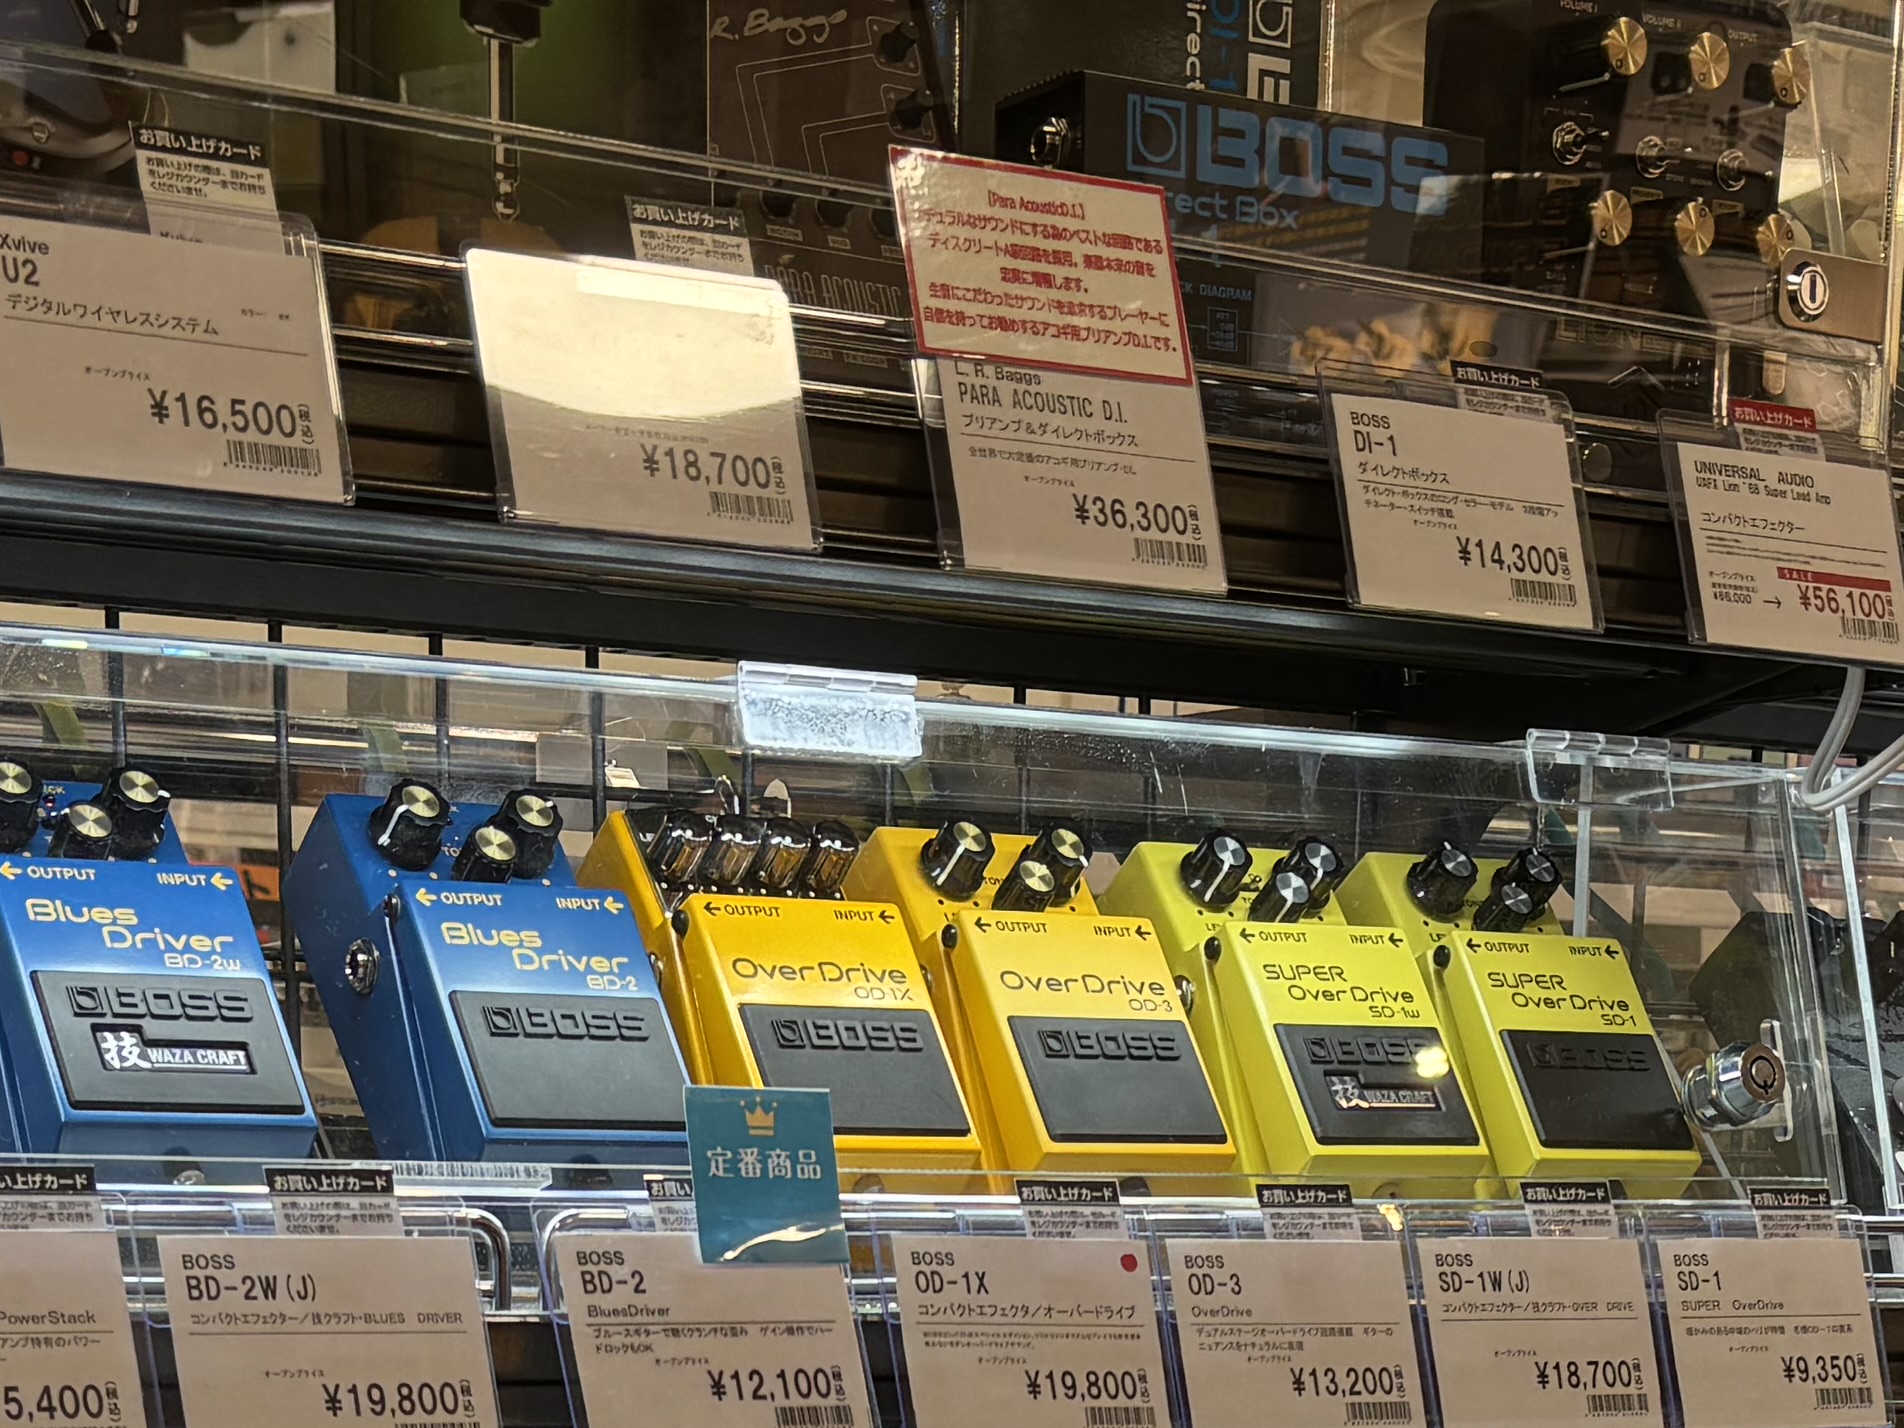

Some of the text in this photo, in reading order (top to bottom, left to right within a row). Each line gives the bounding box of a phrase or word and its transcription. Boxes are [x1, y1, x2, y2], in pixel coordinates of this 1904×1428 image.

[1198, 111, 1449, 213] BOSS
[1, 257, 39, 286] U2
[7, 294, 219, 336] デジタルワイヤレスシステム
[149, 388, 296, 439] ¥16,500
[958, 381, 1001, 407] PARA
[1012, 388, 1092, 421] ACOUSTIC
[1074, 493, 1187, 537] ¥36,300
[1457, 536, 1560, 577] ¥14,300
[1798, 585, 1887, 620] ¥56,100
[26, 899, 137, 926] Blues
[103, 927, 233, 952] Driver
[442, 923, 541, 947] Blues
[512, 948, 628, 974] Driver
[587, 973, 637, 991] BD-2
[854, 985, 913, 1002] OD-1X
[1129, 998, 1172, 1014] OD-3
[150, 1048, 246, 1069] WAZA CRAFT
[706, 1145, 821, 1182] 定番商品
[581, 1271, 647, 1295] BD-2
[916, 1271, 989, 1295] OD-1X
[1188, 1273, 1241, 1296] OD-3
[1678, 1270, 1721, 1291] SD-1
[588, 1305, 670, 1318] BluesDriver
[1782, 1355, 1856, 1383] ¥9,350
[710, 1369, 832, 1401] ¥12,100
